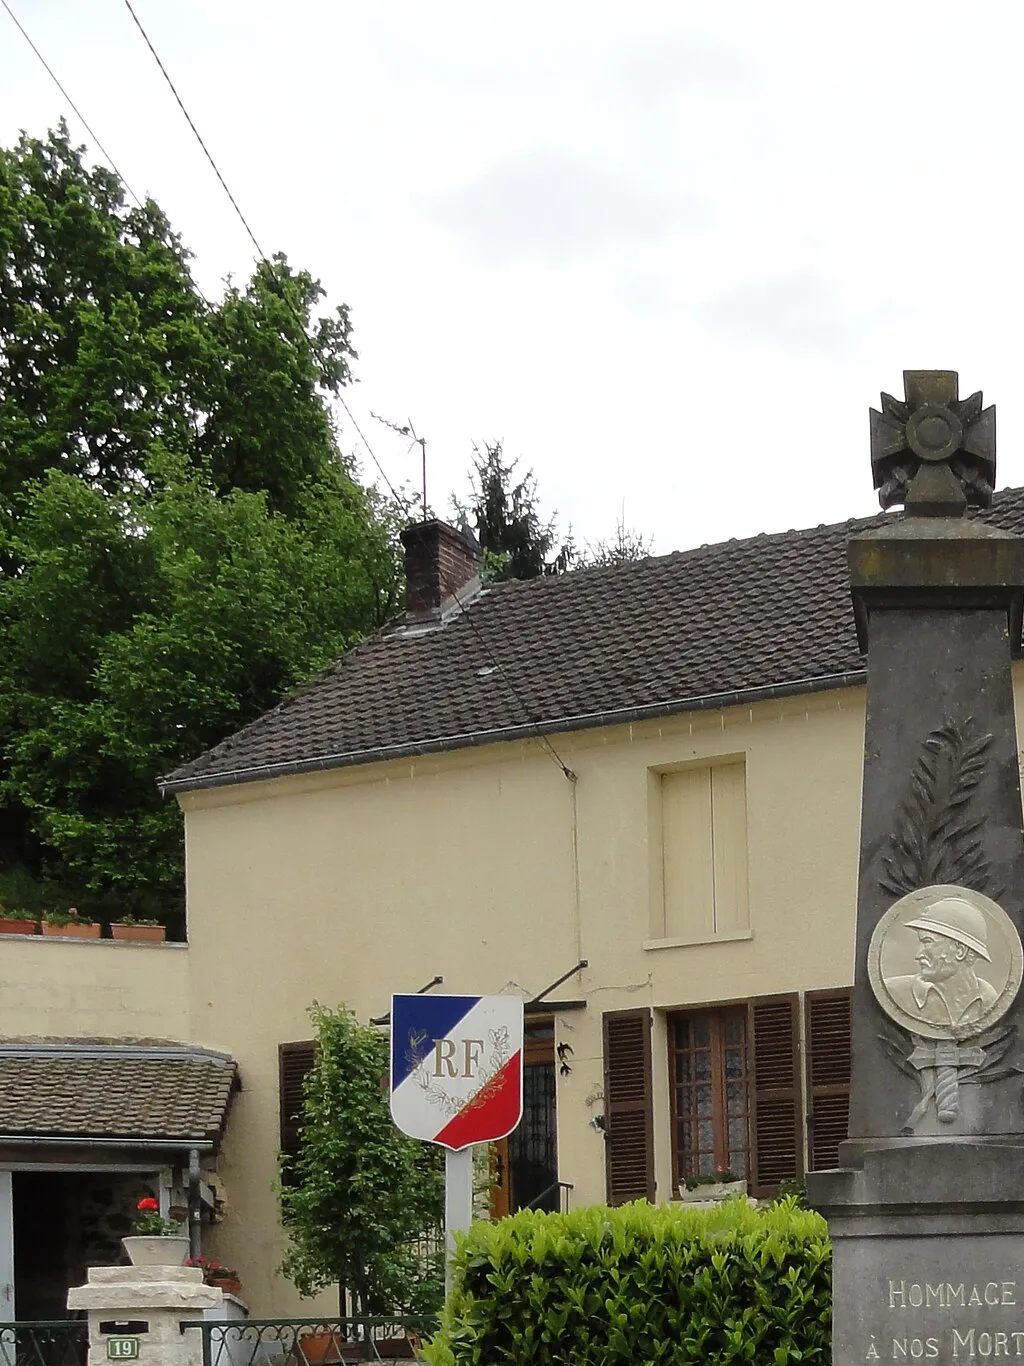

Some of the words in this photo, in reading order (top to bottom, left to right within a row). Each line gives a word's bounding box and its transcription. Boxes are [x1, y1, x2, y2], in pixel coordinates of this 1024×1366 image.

[432, 1039, 485, 1078] RF
[888, 1280, 1017, 1308] HOMMAGE
[113, 1341, 133, 1356] 19
[892, 1337, 940, 1359] NOS
